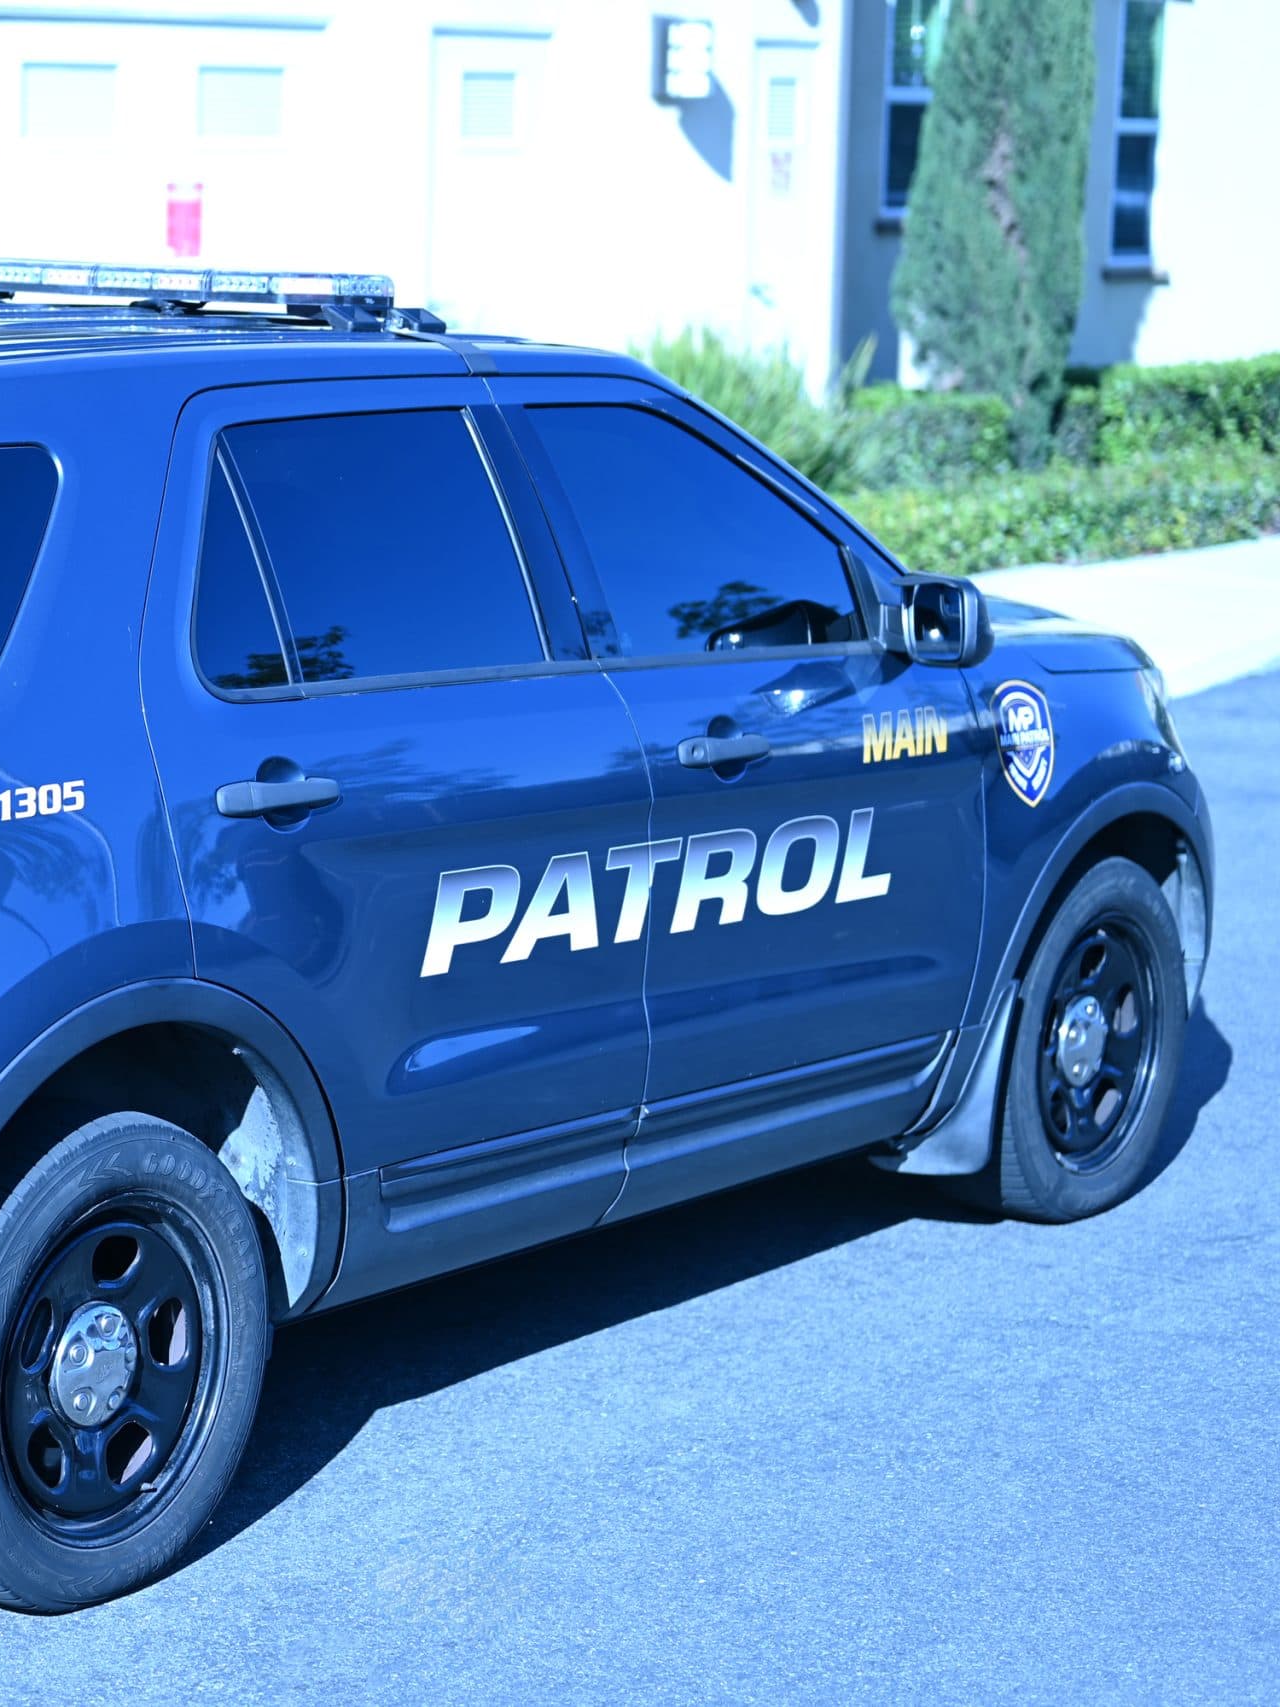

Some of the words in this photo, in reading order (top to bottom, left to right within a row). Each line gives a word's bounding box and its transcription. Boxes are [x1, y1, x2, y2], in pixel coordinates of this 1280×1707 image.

[861, 706, 948, 764] MAIN
[1008, 705, 1034, 732] MP
[420, 807, 892, 979] PATROL
